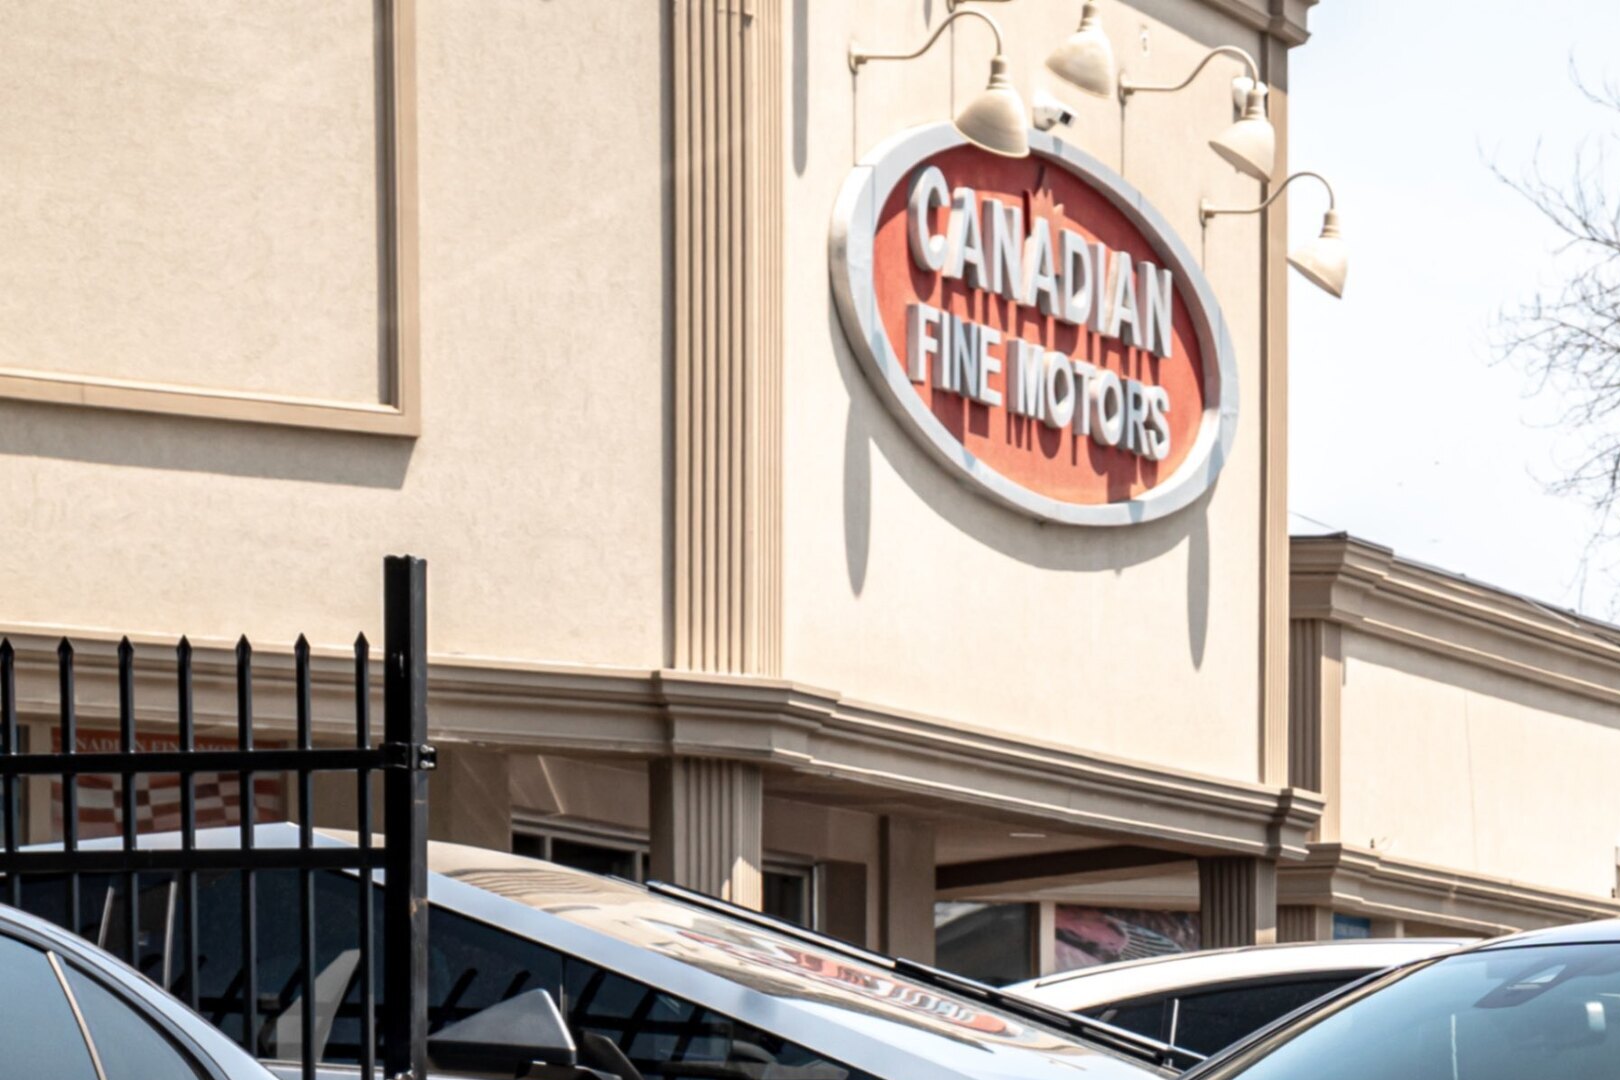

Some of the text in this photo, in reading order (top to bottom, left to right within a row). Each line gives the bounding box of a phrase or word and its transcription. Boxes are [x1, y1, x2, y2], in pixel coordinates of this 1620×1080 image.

[906, 166, 1173, 359] CANADIAN
[906, 302, 1171, 461] FINE MOTORS
